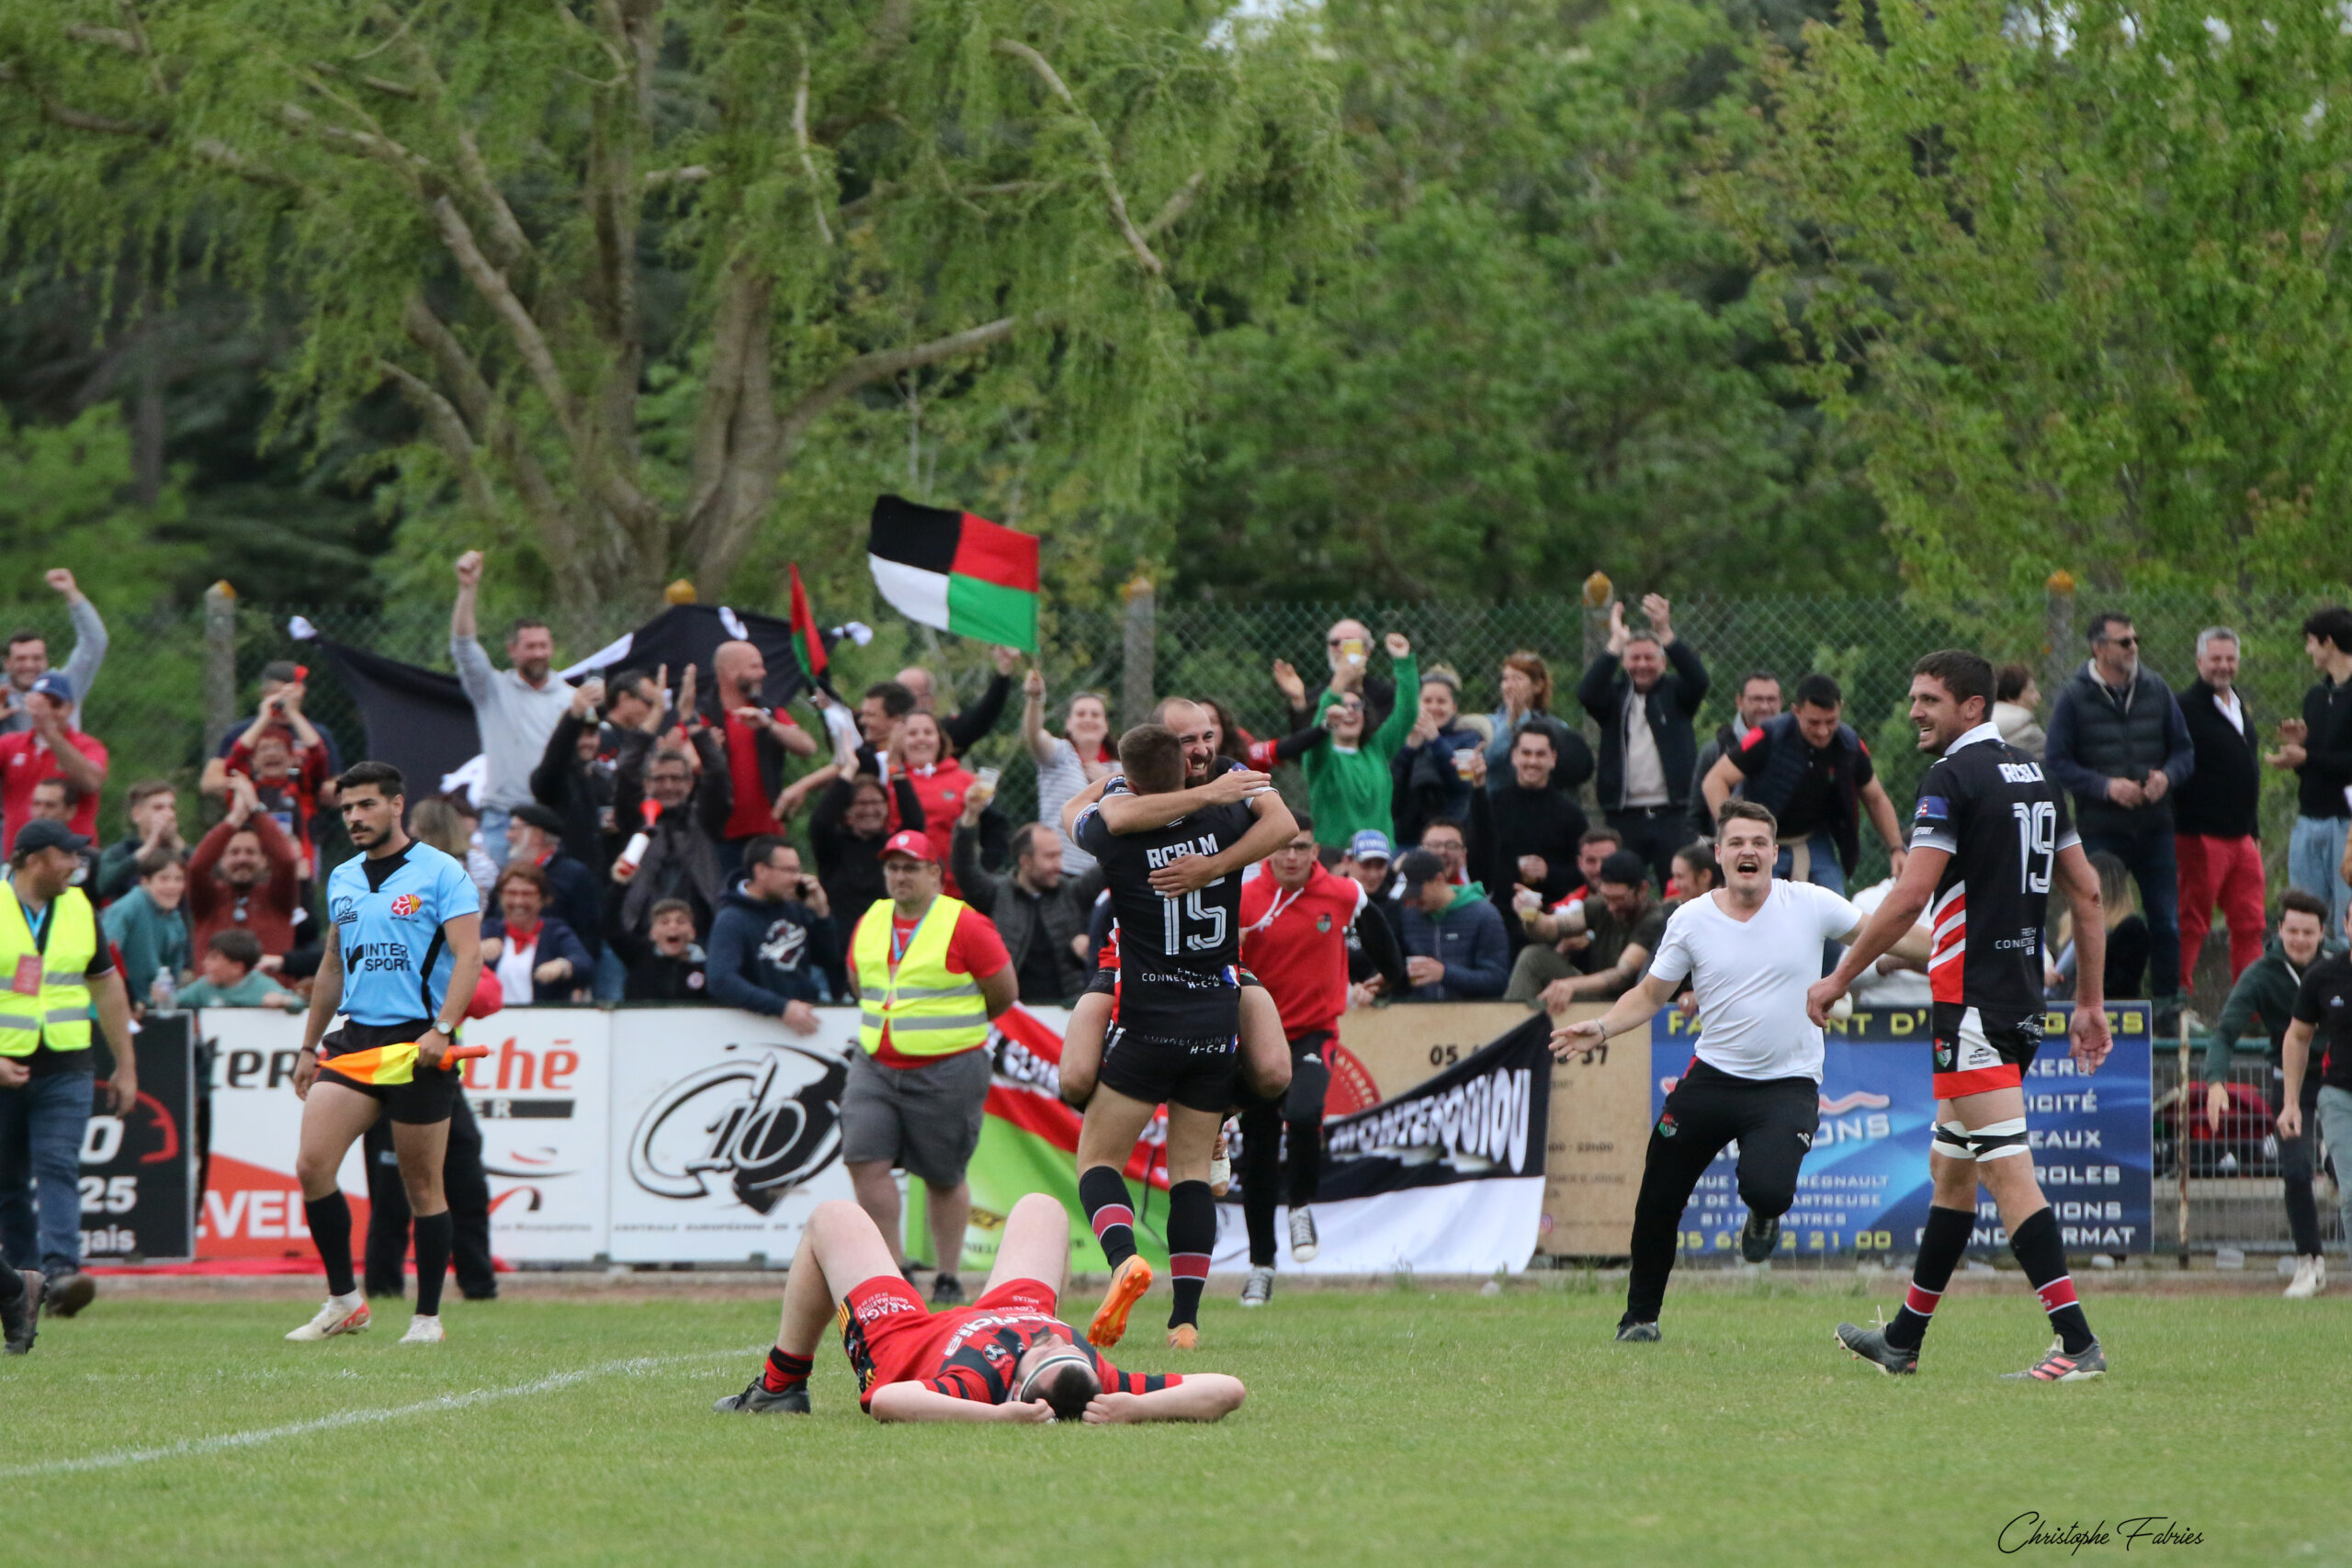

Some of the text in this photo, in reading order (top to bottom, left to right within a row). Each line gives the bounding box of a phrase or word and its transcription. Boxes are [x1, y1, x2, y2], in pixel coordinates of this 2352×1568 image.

[1146, 832, 1219, 869] RCBLM
[2012, 801, 2057, 895] 19
[1154, 876, 1227, 956] 15
[365, 942, 409, 959] INTER
[365, 958, 412, 972] SPORT
[1190, 1043, 1227, 1055] H-C-B
[2025, 1087, 2098, 1113] ICITÉ
[2029, 1130, 2102, 1149] EAUX
[1696, 1175, 1729, 1188] RUE
[2037, 1166, 2121, 1185] ROLES
[1705, 1194, 1730, 1207] DE
[1792, 1193, 1883, 1208] ARTREUSE
[1779, 1213, 1848, 1227] ASTRES
[1855, 1230, 1892, 1250] 00
